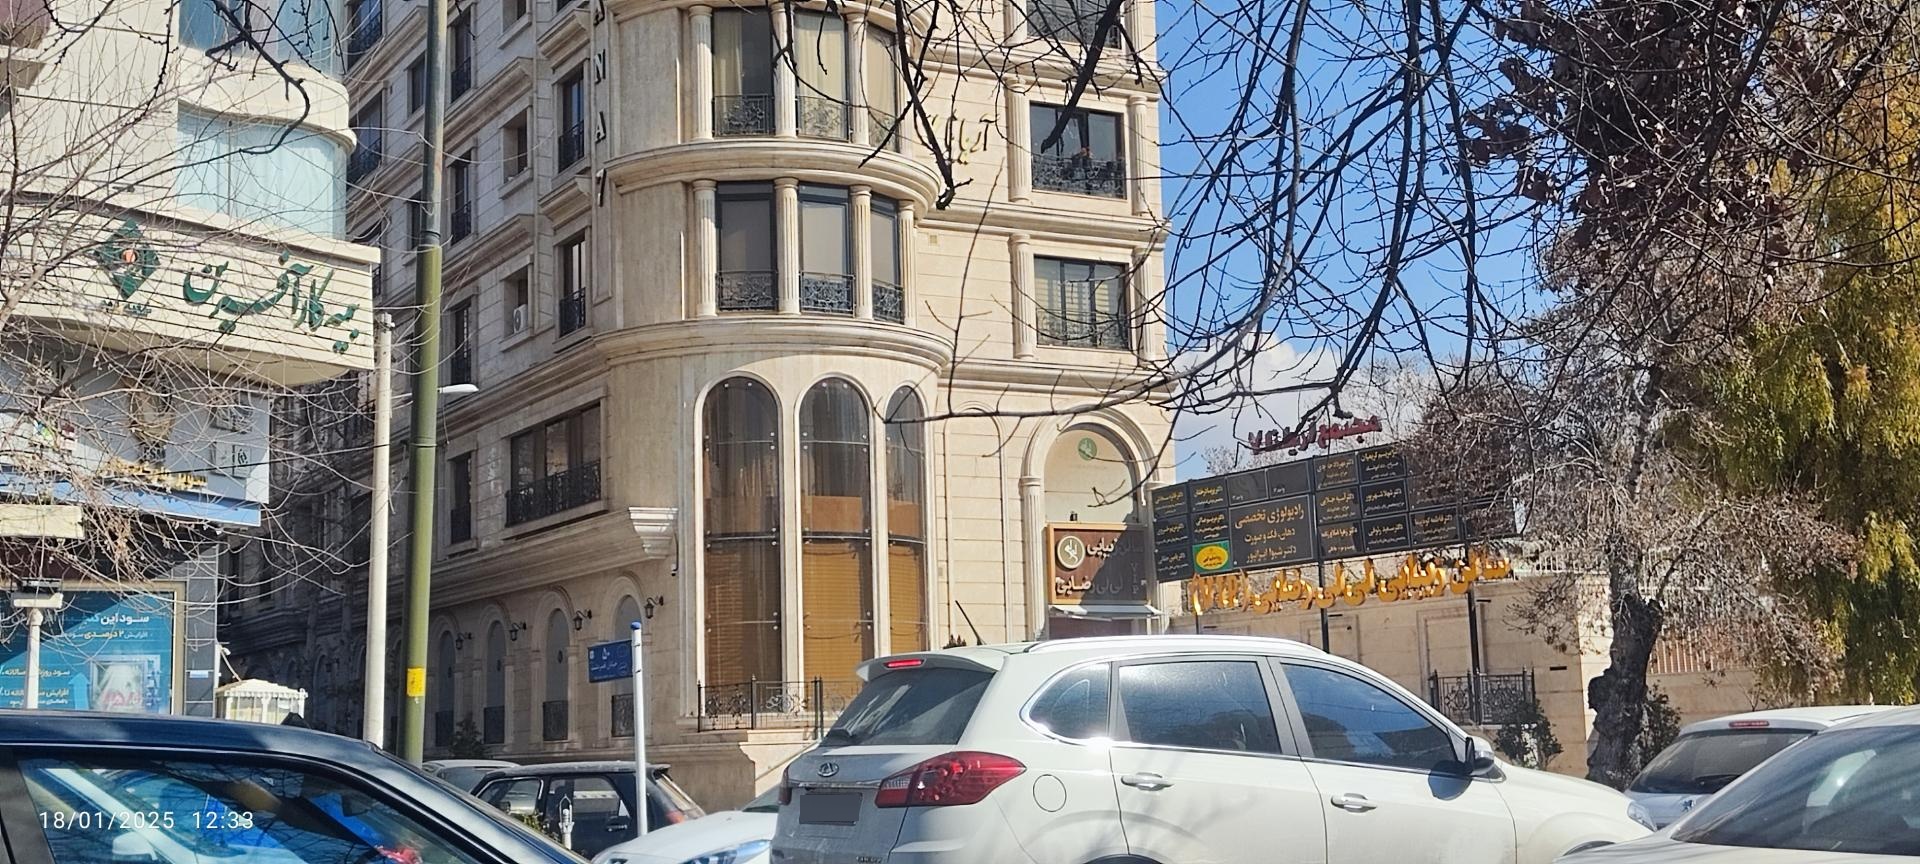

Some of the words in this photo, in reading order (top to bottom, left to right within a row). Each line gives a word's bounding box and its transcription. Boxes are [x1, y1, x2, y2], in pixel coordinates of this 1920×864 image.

[1234, 508, 1266, 529] تخصصی
[1266, 502, 1305, 524] رادیولوژی
[1270, 547, 1284, 561] شیوا
[1283, 545, 1297, 558] دکتر
[1378, 553, 1446, 602] زیبایی
[1251, 567, 1314, 615] رضایی
[100, 612, 118, 625] این
[119, 614, 150, 625] سود
[83, 630, 116, 640] درصدی
[52, 668, 70, 677] سود
